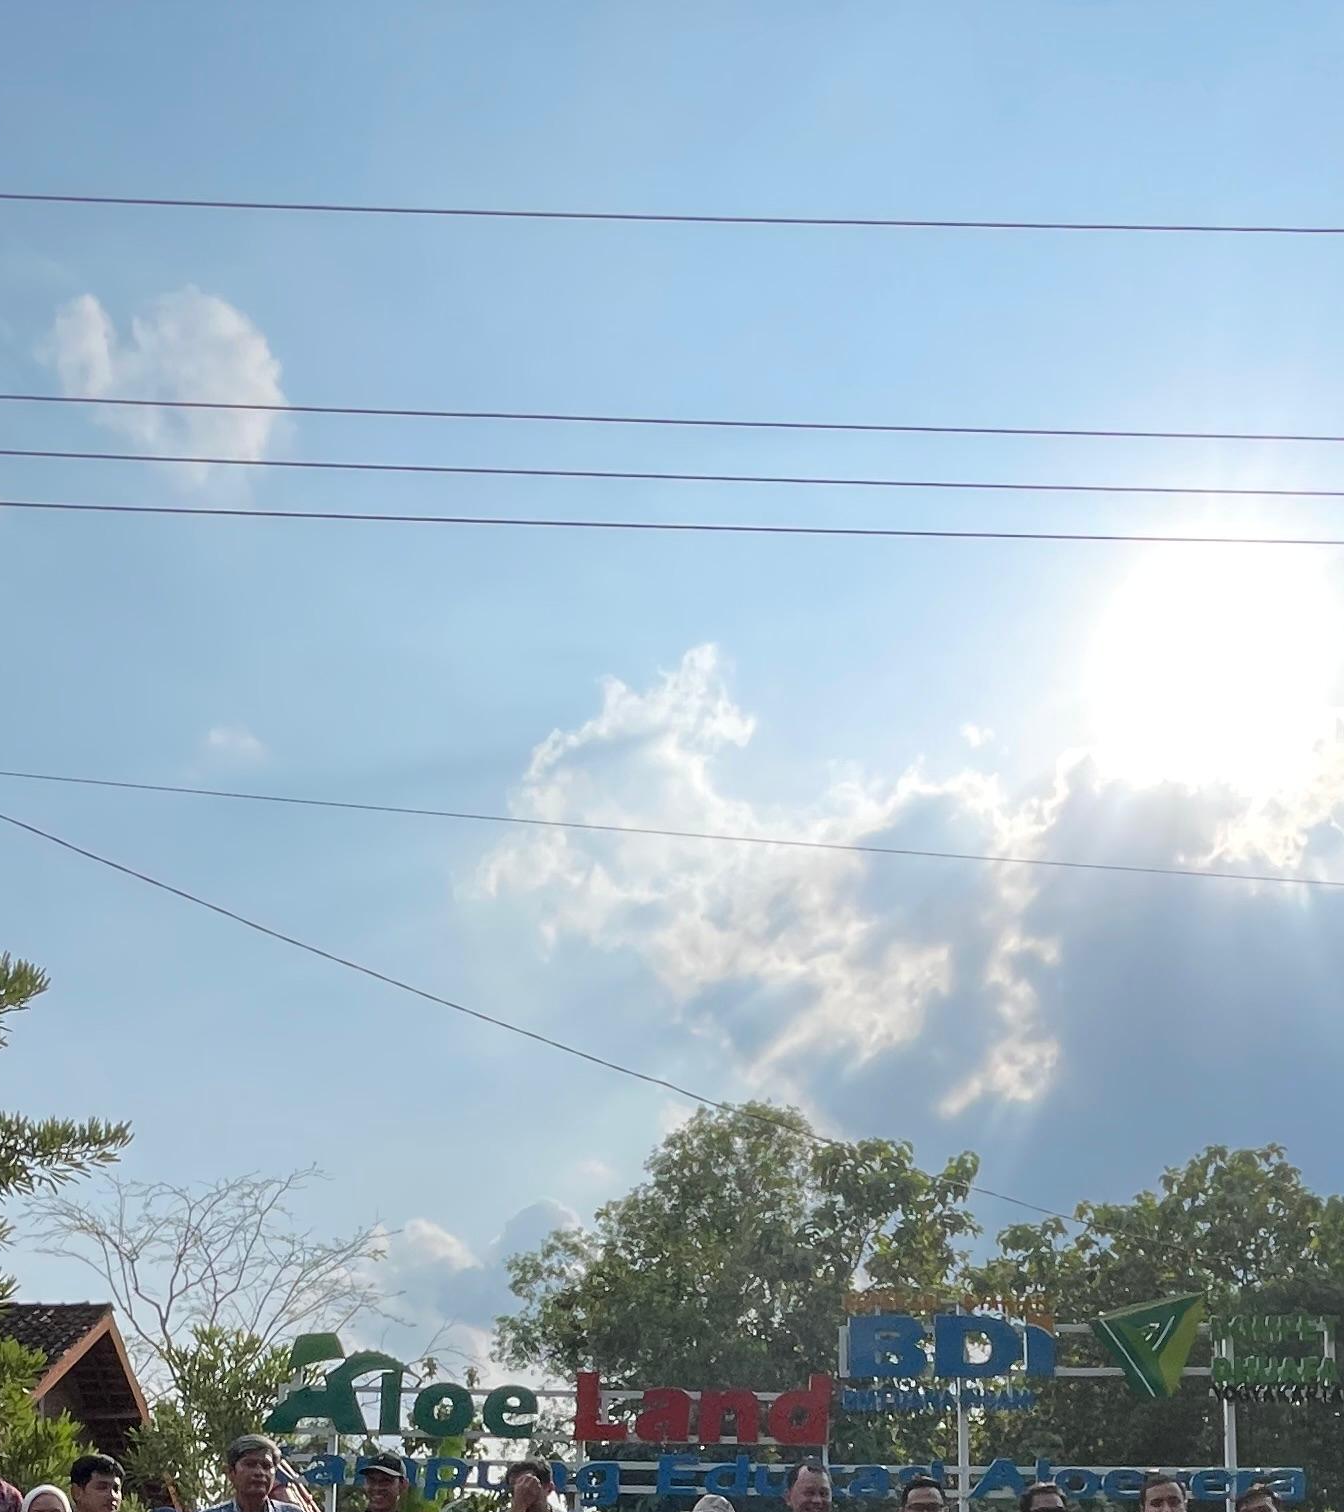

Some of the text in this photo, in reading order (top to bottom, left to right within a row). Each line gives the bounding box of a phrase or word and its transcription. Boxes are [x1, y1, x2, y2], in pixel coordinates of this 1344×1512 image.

[262, 1331, 833, 1446] Aloe Land
[967, 1457, 1306, 1502] Aloeera
